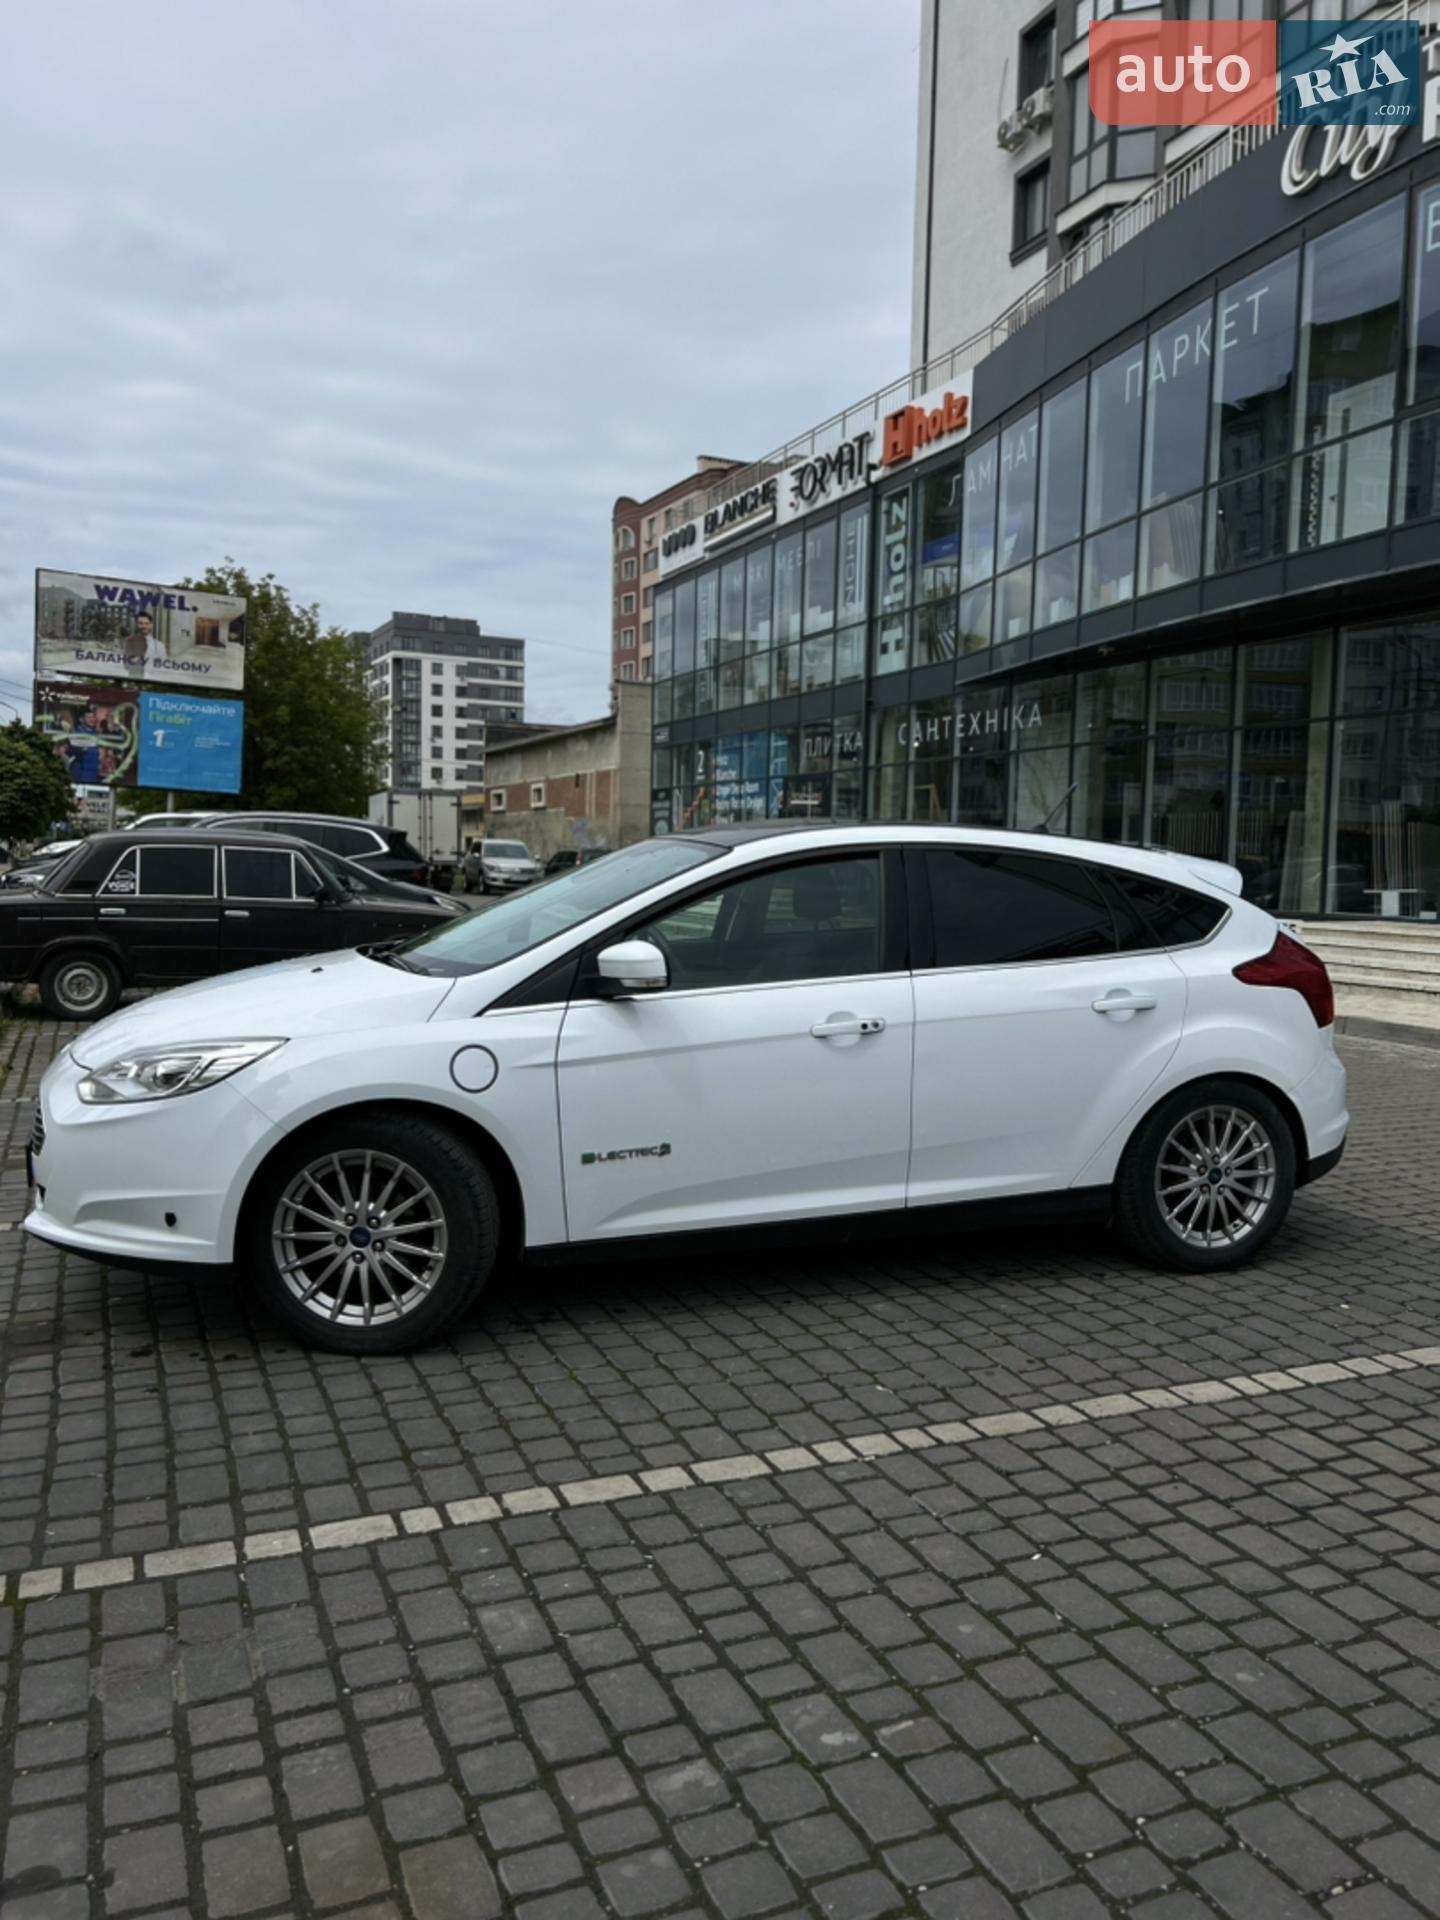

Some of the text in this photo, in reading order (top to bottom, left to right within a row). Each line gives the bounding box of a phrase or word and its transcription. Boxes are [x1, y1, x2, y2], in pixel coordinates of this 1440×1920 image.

[1125, 286, 1269, 404] ПАРКЕТ
[948, 424, 1038, 507] ЛАМІНАТ
[704, 478, 778, 534] BLANCHE
[75, 650, 136, 666] БАЛАНС
[153, 657, 213, 674] ВСЬОМУ
[804, 731, 863, 758] ПЛИТКА
[897, 702, 1043, 745] САНТЕХНІКА
